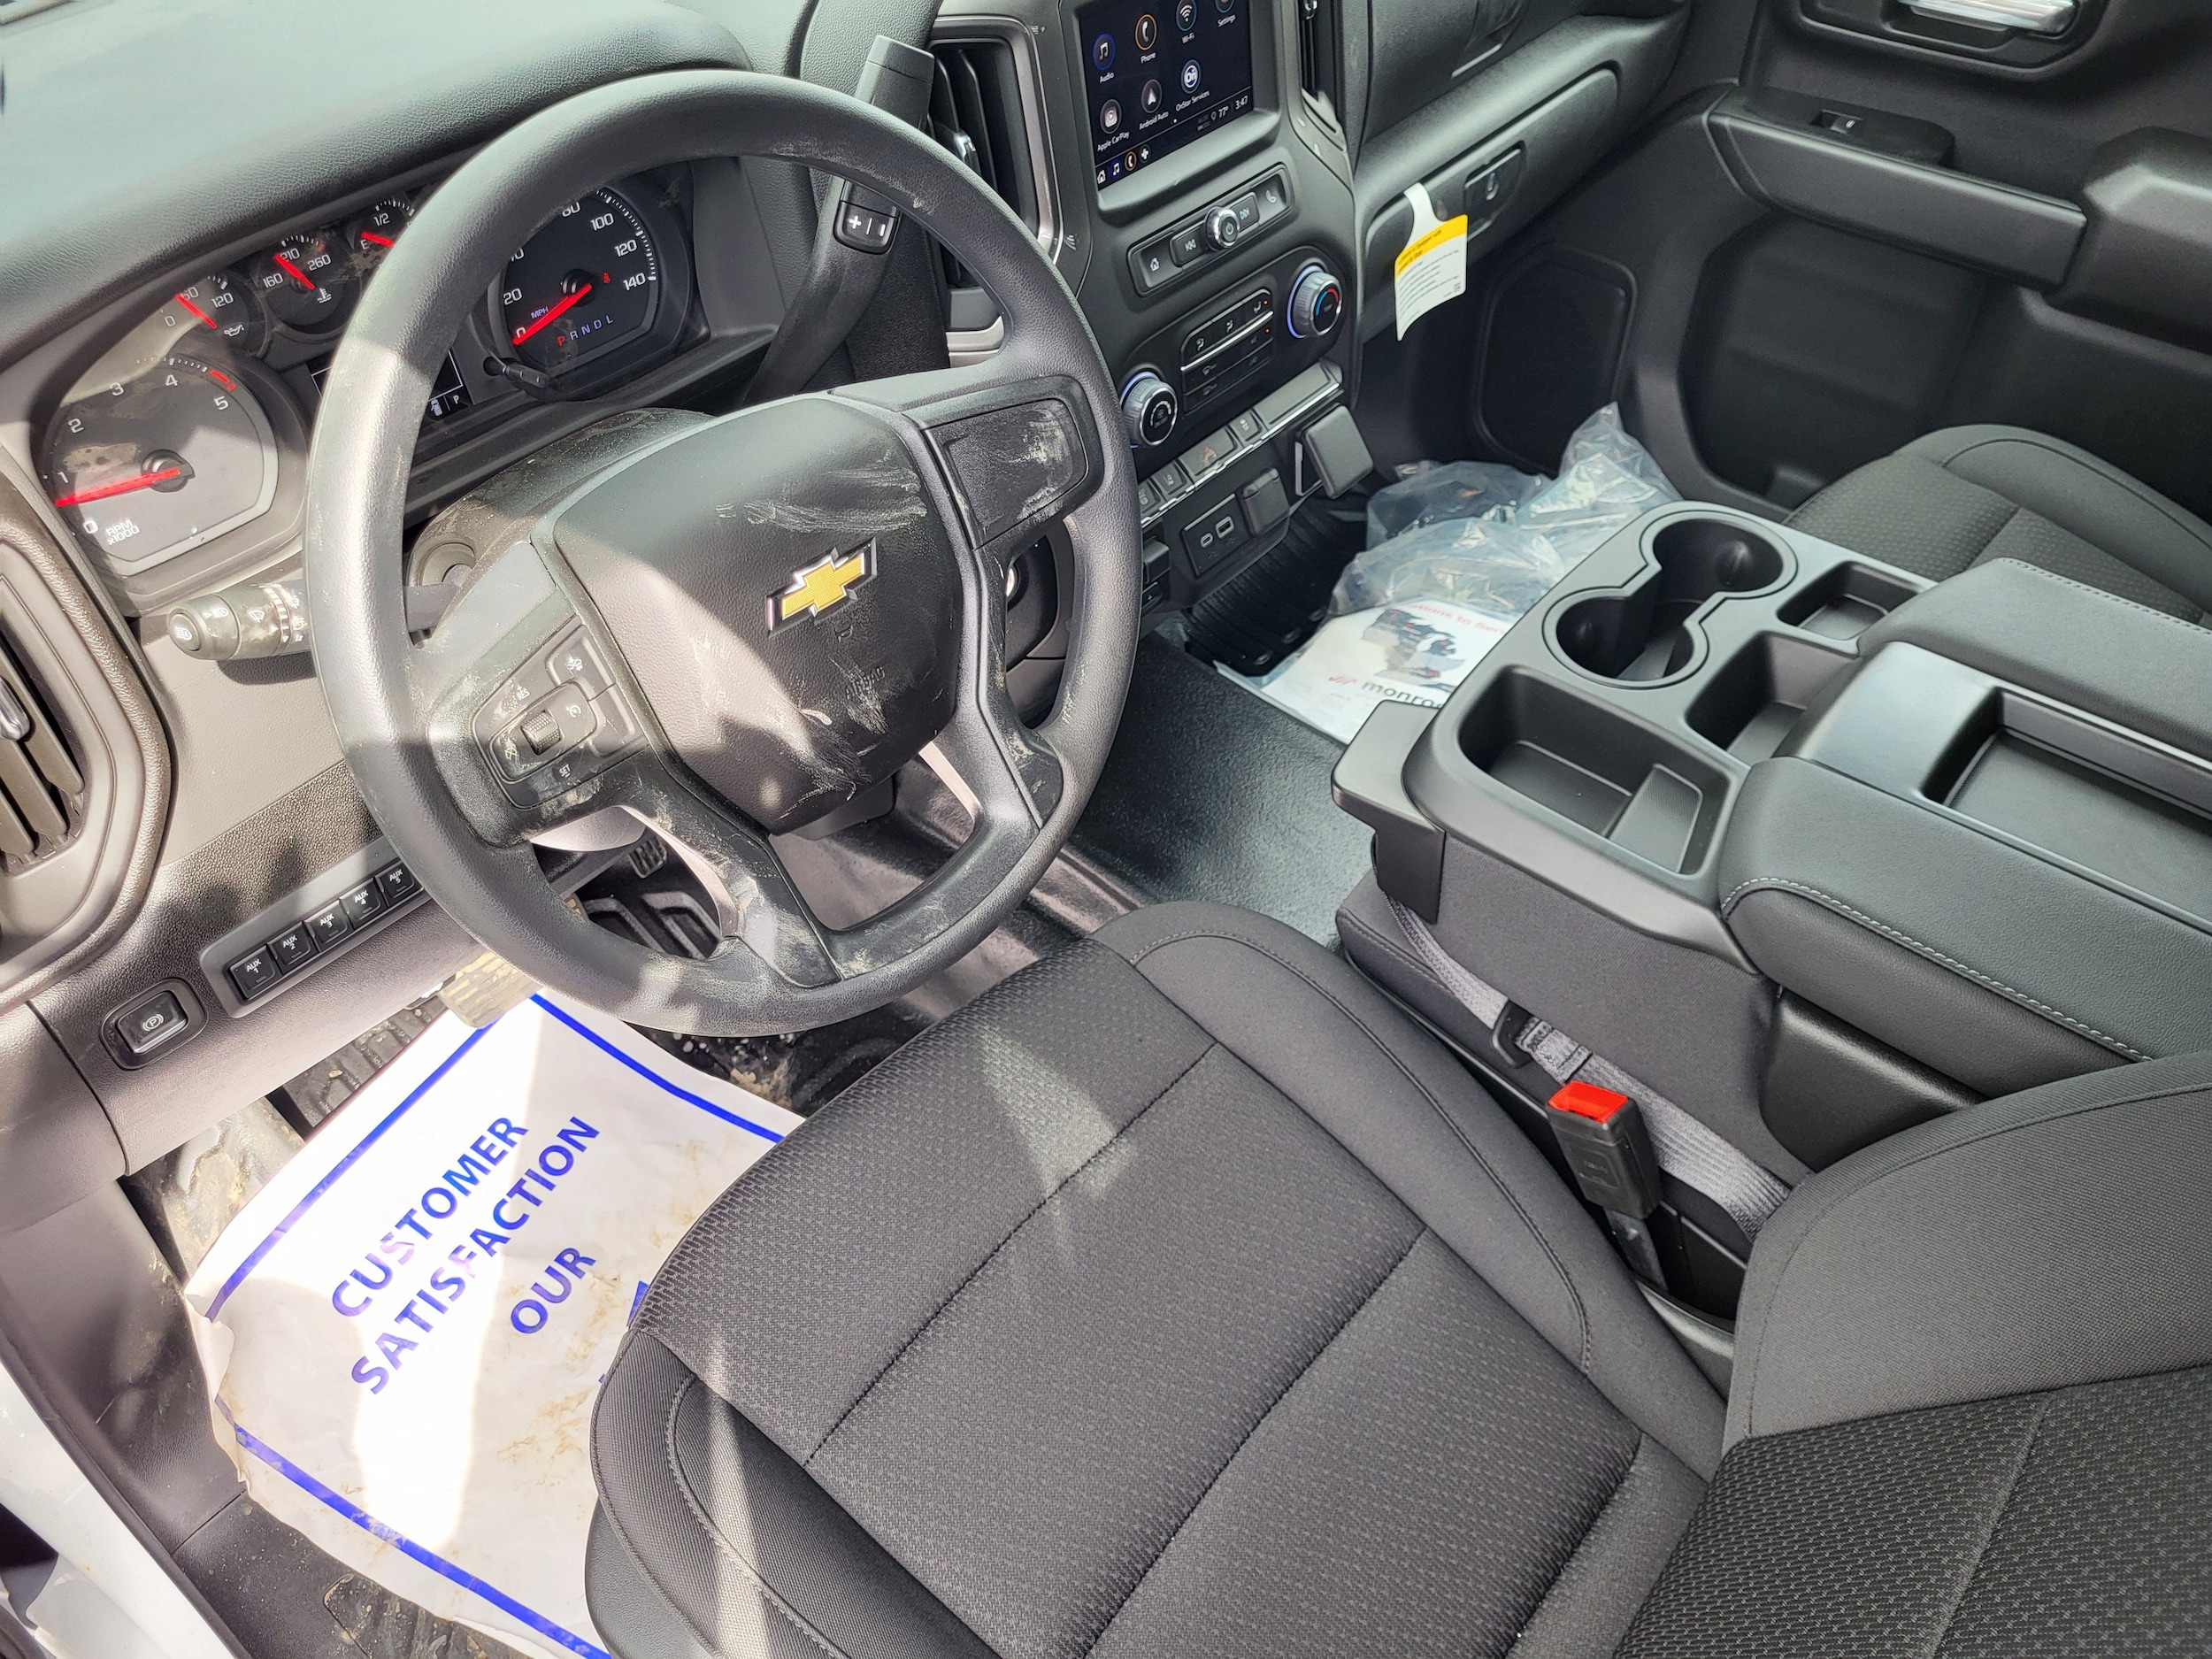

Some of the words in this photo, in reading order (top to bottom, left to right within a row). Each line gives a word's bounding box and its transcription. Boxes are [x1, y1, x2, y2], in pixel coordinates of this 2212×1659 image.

[1217, 14, 1236, 27] Settings
[1181, 32, 1195, 44] Wi-Fi
[1141, 52, 1156, 64] Phone
[1099, 72, 1115, 84] Audio
[1175, 99, 1192, 111] OnStar
[1191, 89, 1210, 104] Services
[1235, 95, 1248, 110] 3:47
[1139, 115, 1157, 130] Android
[1157, 111, 1169, 122] Auto
[1097, 139, 1111, 152] Apple
[1111, 131, 1130, 145] CarPlay
[373, 212, 390, 227] 1/2
[590, 212, 614, 231] 100
[360, 239, 369, 250] E
[614, 239, 637, 257] 120
[307, 254, 332, 272] 260
[263, 273, 283, 288] 160
[623, 273, 646, 291] 140
[211, 292, 234, 308] 120
[503, 288, 523, 306] 20
[531, 306, 549, 319] MPH
[165, 315, 176, 327] 0
[557, 335, 565, 347] P
[570, 330, 579, 341] R
[581, 324, 591, 335] N
[594, 319, 603, 330] D
[606, 315, 613, 325] L
[165, 374, 179, 388] 4
[109, 381, 125, 397] 3
[214, 396, 229, 411] 5
[453, 394, 459, 405] P
[68, 418, 85, 434] 2
[58, 471, 69, 484] 1
[83, 519, 98, 534] 0
[105, 518, 134, 537] RPM
[107, 526, 141, 545] x1000
[517, 688, 530, 701] RES
[559, 764, 571, 777] SET
[389, 868, 403, 882] AUX
[354, 889, 369, 903] AUX
[319, 912, 334, 926] AUX
[282, 934, 297, 949] AUX
[246, 958, 262, 972] AUX
[332, 1118, 529, 1317] CUSTOMER
[350, 1116, 600, 1395] SATISFACTION
[511, 1248, 596, 1334] OUR
